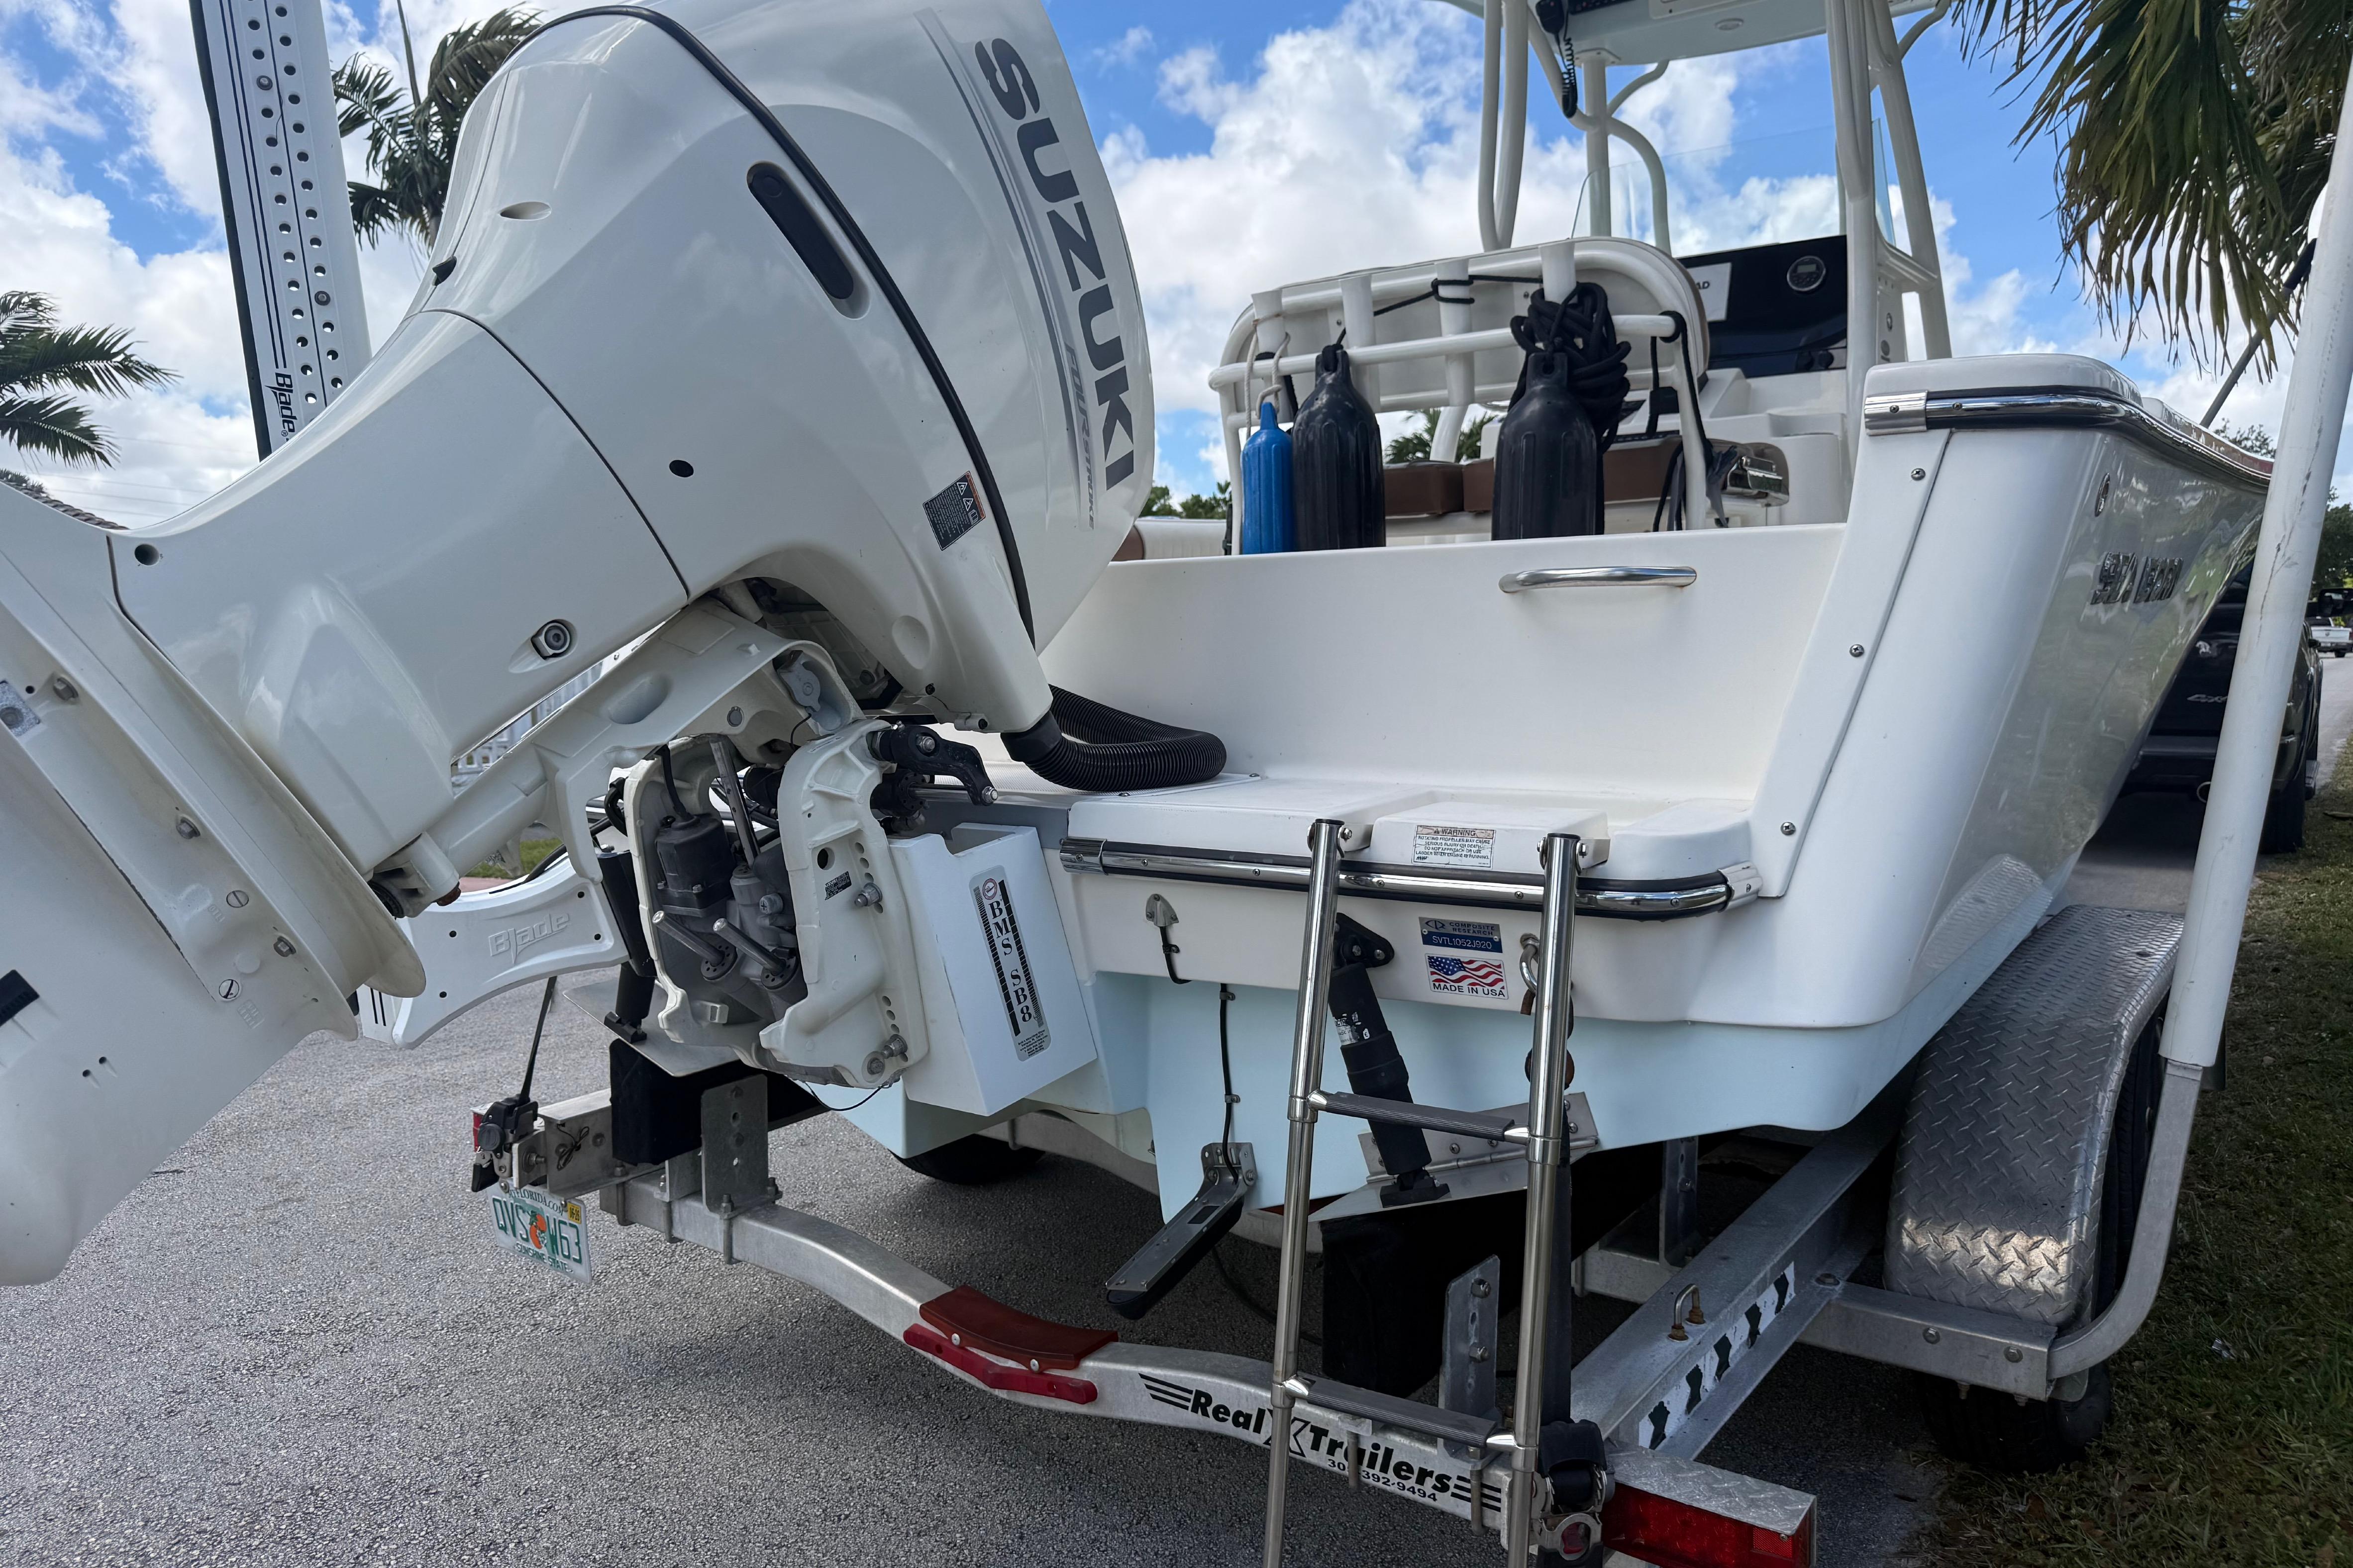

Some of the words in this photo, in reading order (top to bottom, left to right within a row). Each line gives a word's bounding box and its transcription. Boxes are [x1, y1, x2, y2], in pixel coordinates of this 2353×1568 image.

[975, 38, 1135, 490] SUZUKI
[264, 372, 298, 433] Blade
[488, 913, 570, 964] Blade
[988, 900, 1013, 956] BMS
[1432, 936, 1492, 949] SVTL1052J920
[1449, 922, 1495, 931] COMPOSITE
[1452, 927, 1493, 936] RESEARCH
[1010, 969, 1032, 1023] SB8
[1433, 982, 1464, 993] MADE
[1482, 988, 1506, 997] USA
[492, 1197, 529, 1243] QVS
[546, 1214, 582, 1264] W63
[516, 1242, 547, 1264] SUNSHINE
[547, 1256, 569, 1273] STATE
[1190, 1389, 1266, 1434] Real
[1309, 1424, 1452, 1494] Trailers
[1328, 1459, 1438, 1502] 30-392-9494
